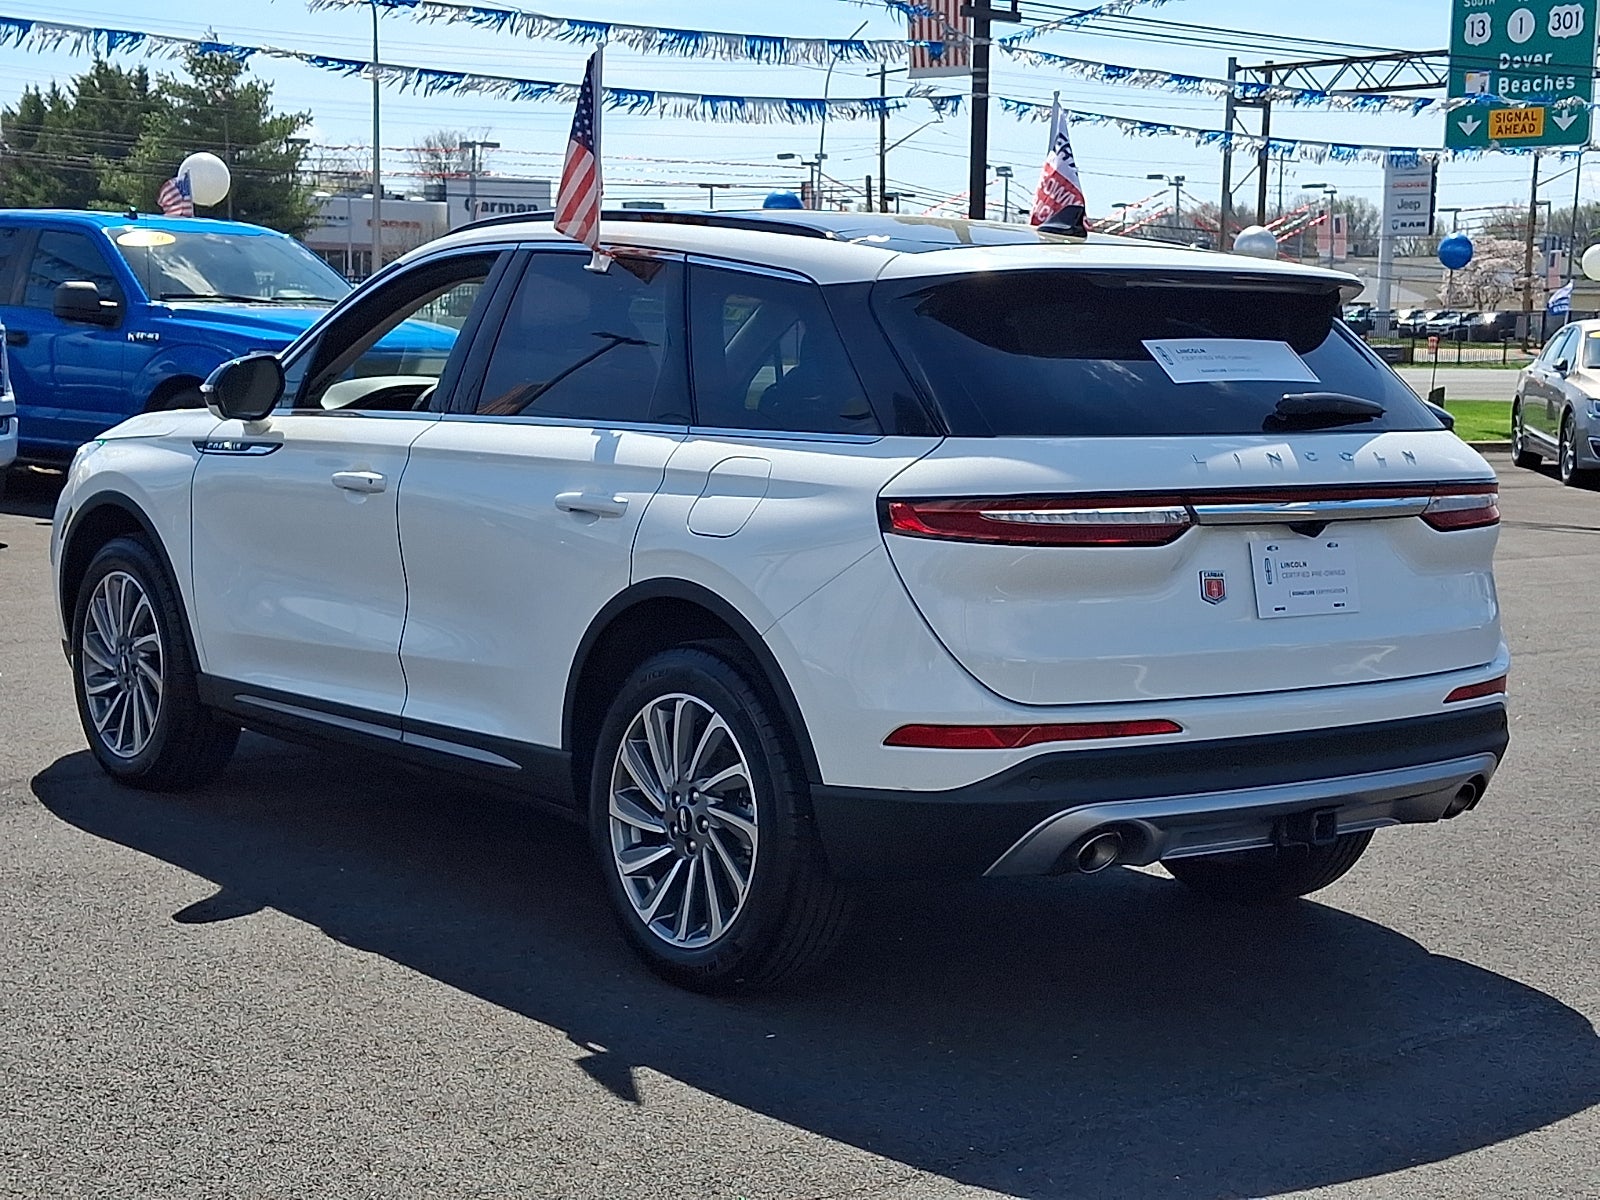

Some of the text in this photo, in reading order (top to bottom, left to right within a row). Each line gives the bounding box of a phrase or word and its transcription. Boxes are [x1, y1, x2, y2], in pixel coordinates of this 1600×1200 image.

[1470, 19, 1486, 38] 13
[1518, 16, 1524, 35] 1
[1551, 11, 1580, 31] 301
[1499, 52, 1553, 70] Dover
[1499, 75, 1576, 94] Beaches
[1495, 111, 1538, 124] SIGNAL
[1495, 123, 1536, 136] AHEAD
[1397, 199, 1421, 211] Jeep
[1190, 450, 1417, 468] LINCOLN
[1280, 561, 1308, 569] LINCOLN
